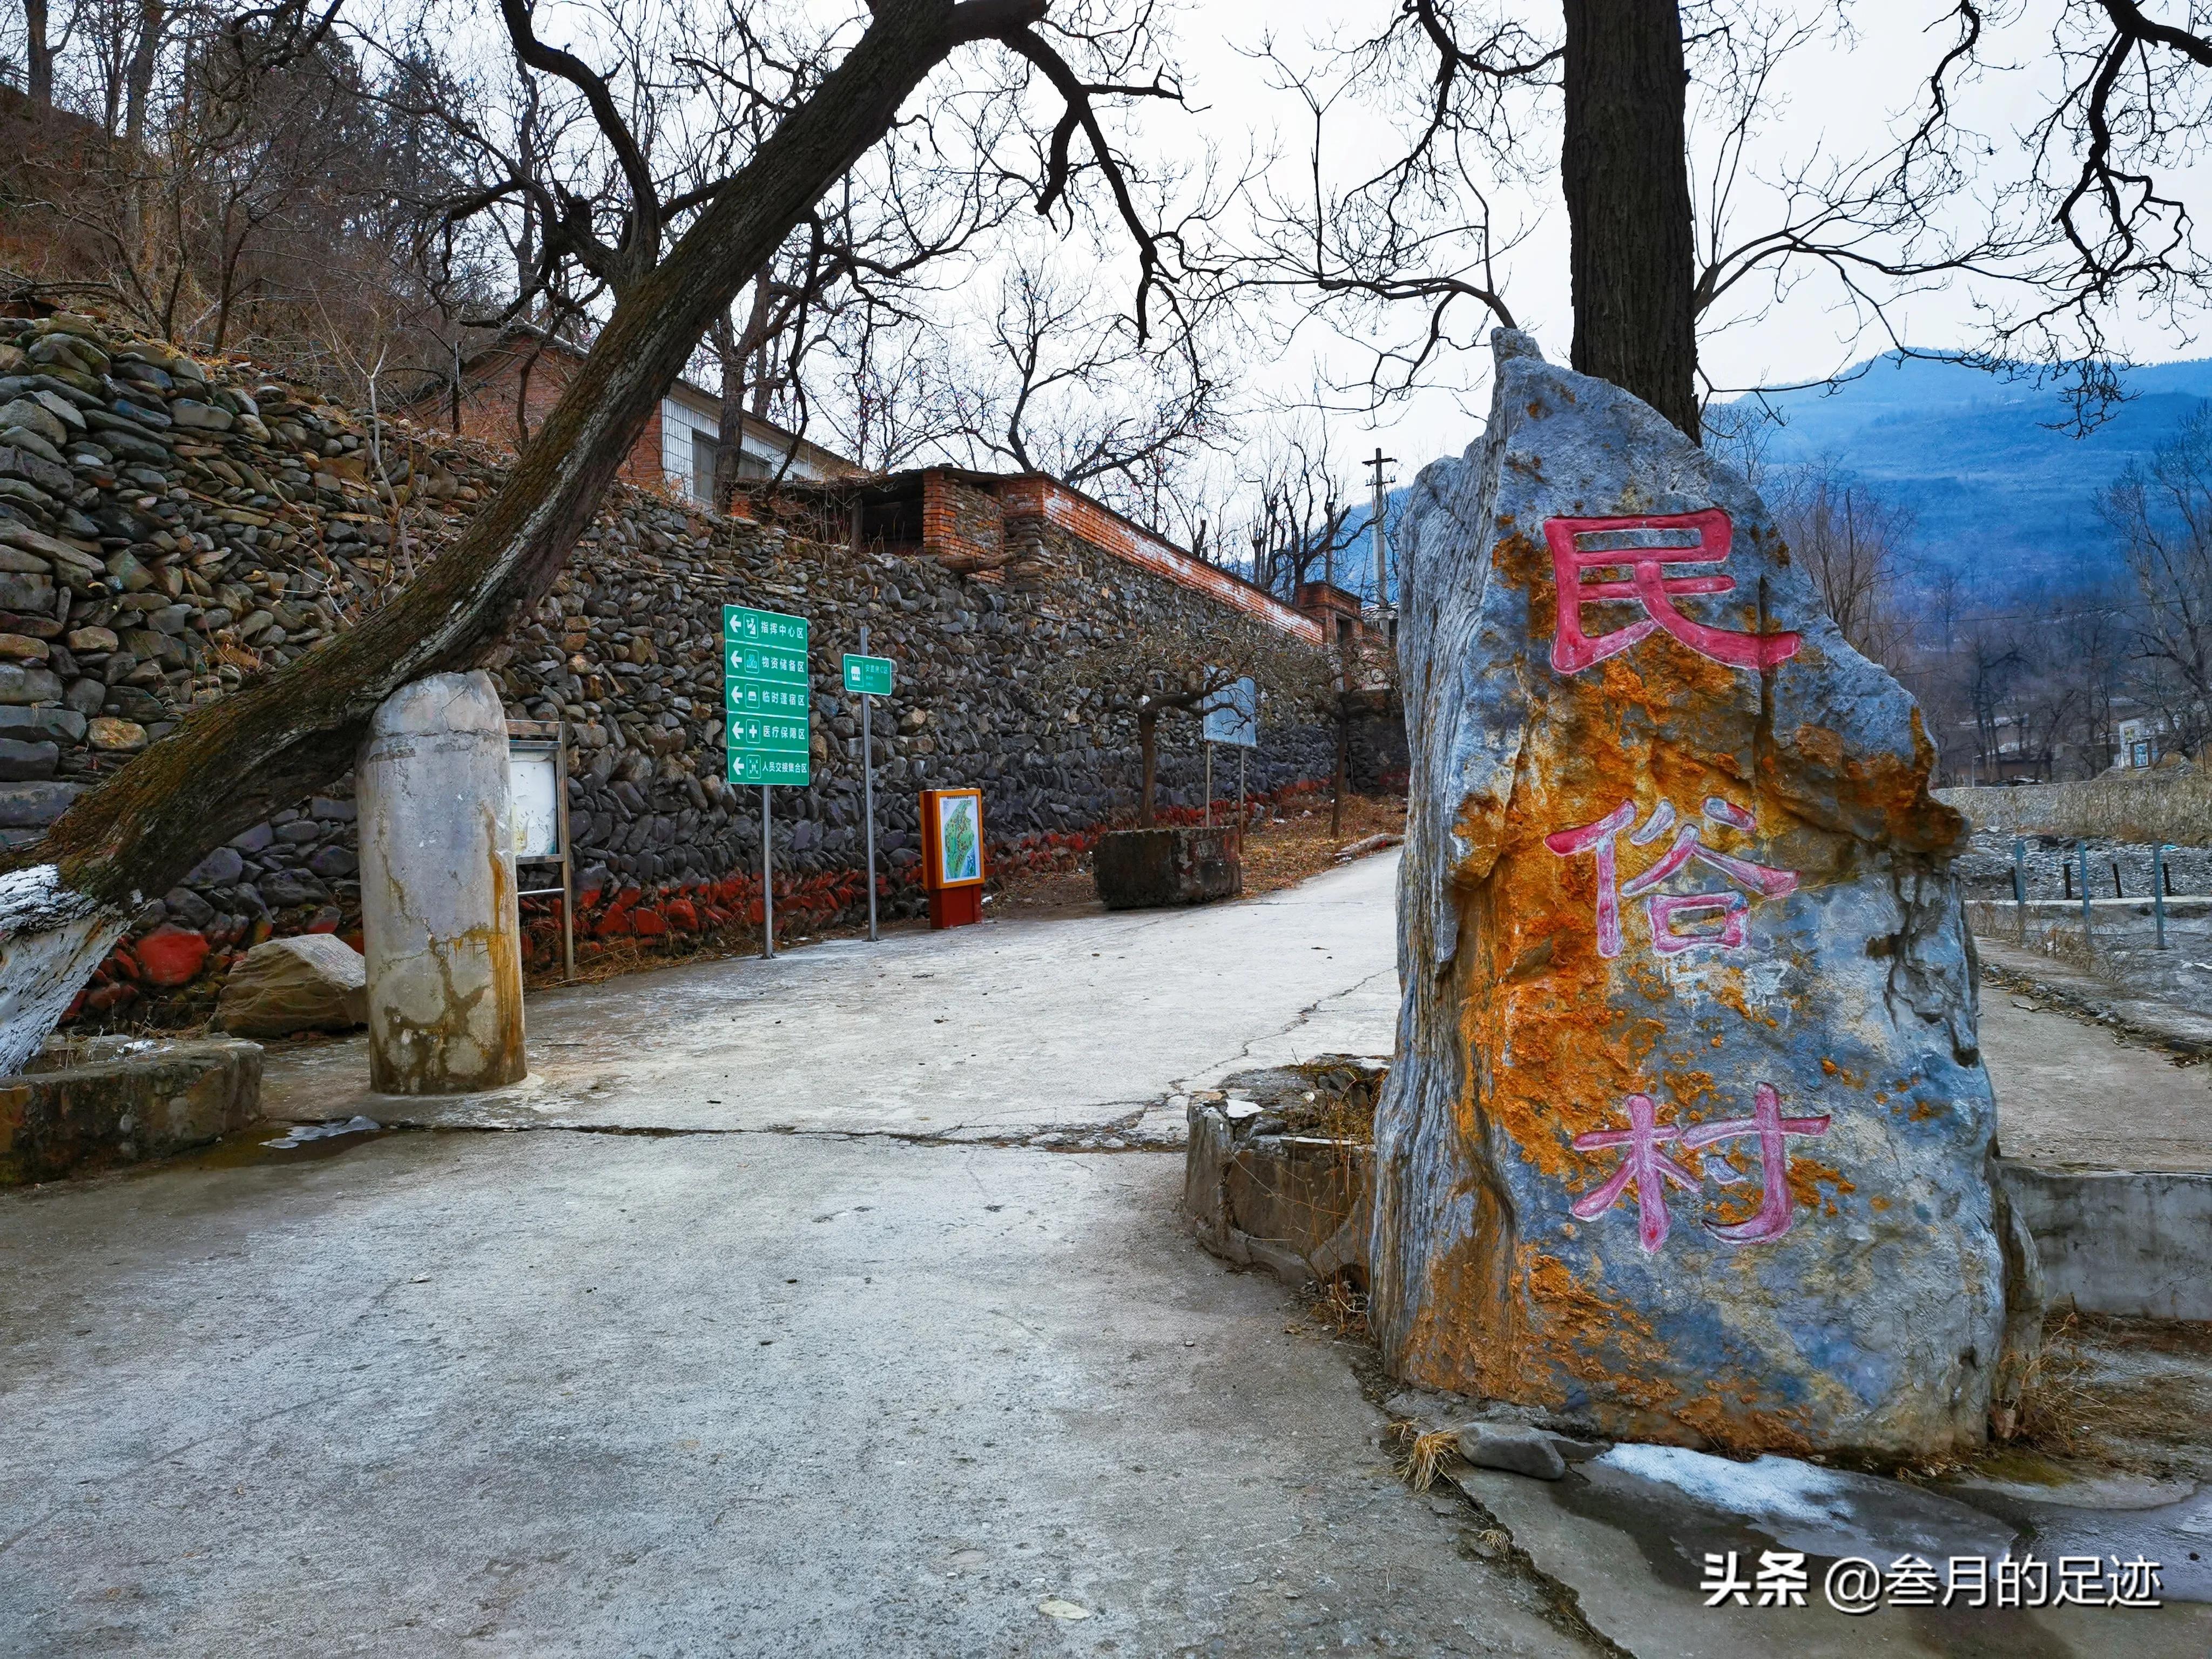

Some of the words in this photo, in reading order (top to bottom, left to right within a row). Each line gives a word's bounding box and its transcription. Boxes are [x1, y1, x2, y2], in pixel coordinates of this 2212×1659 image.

[760, 620, 804, 639] 指挥中心区
[761, 656, 805, 673] 物资储备区
[763, 725, 805, 740] 医疗保障区
[762, 760, 807, 773] 人员交接集合区
[1542, 507, 1831, 1254] 民俗村
